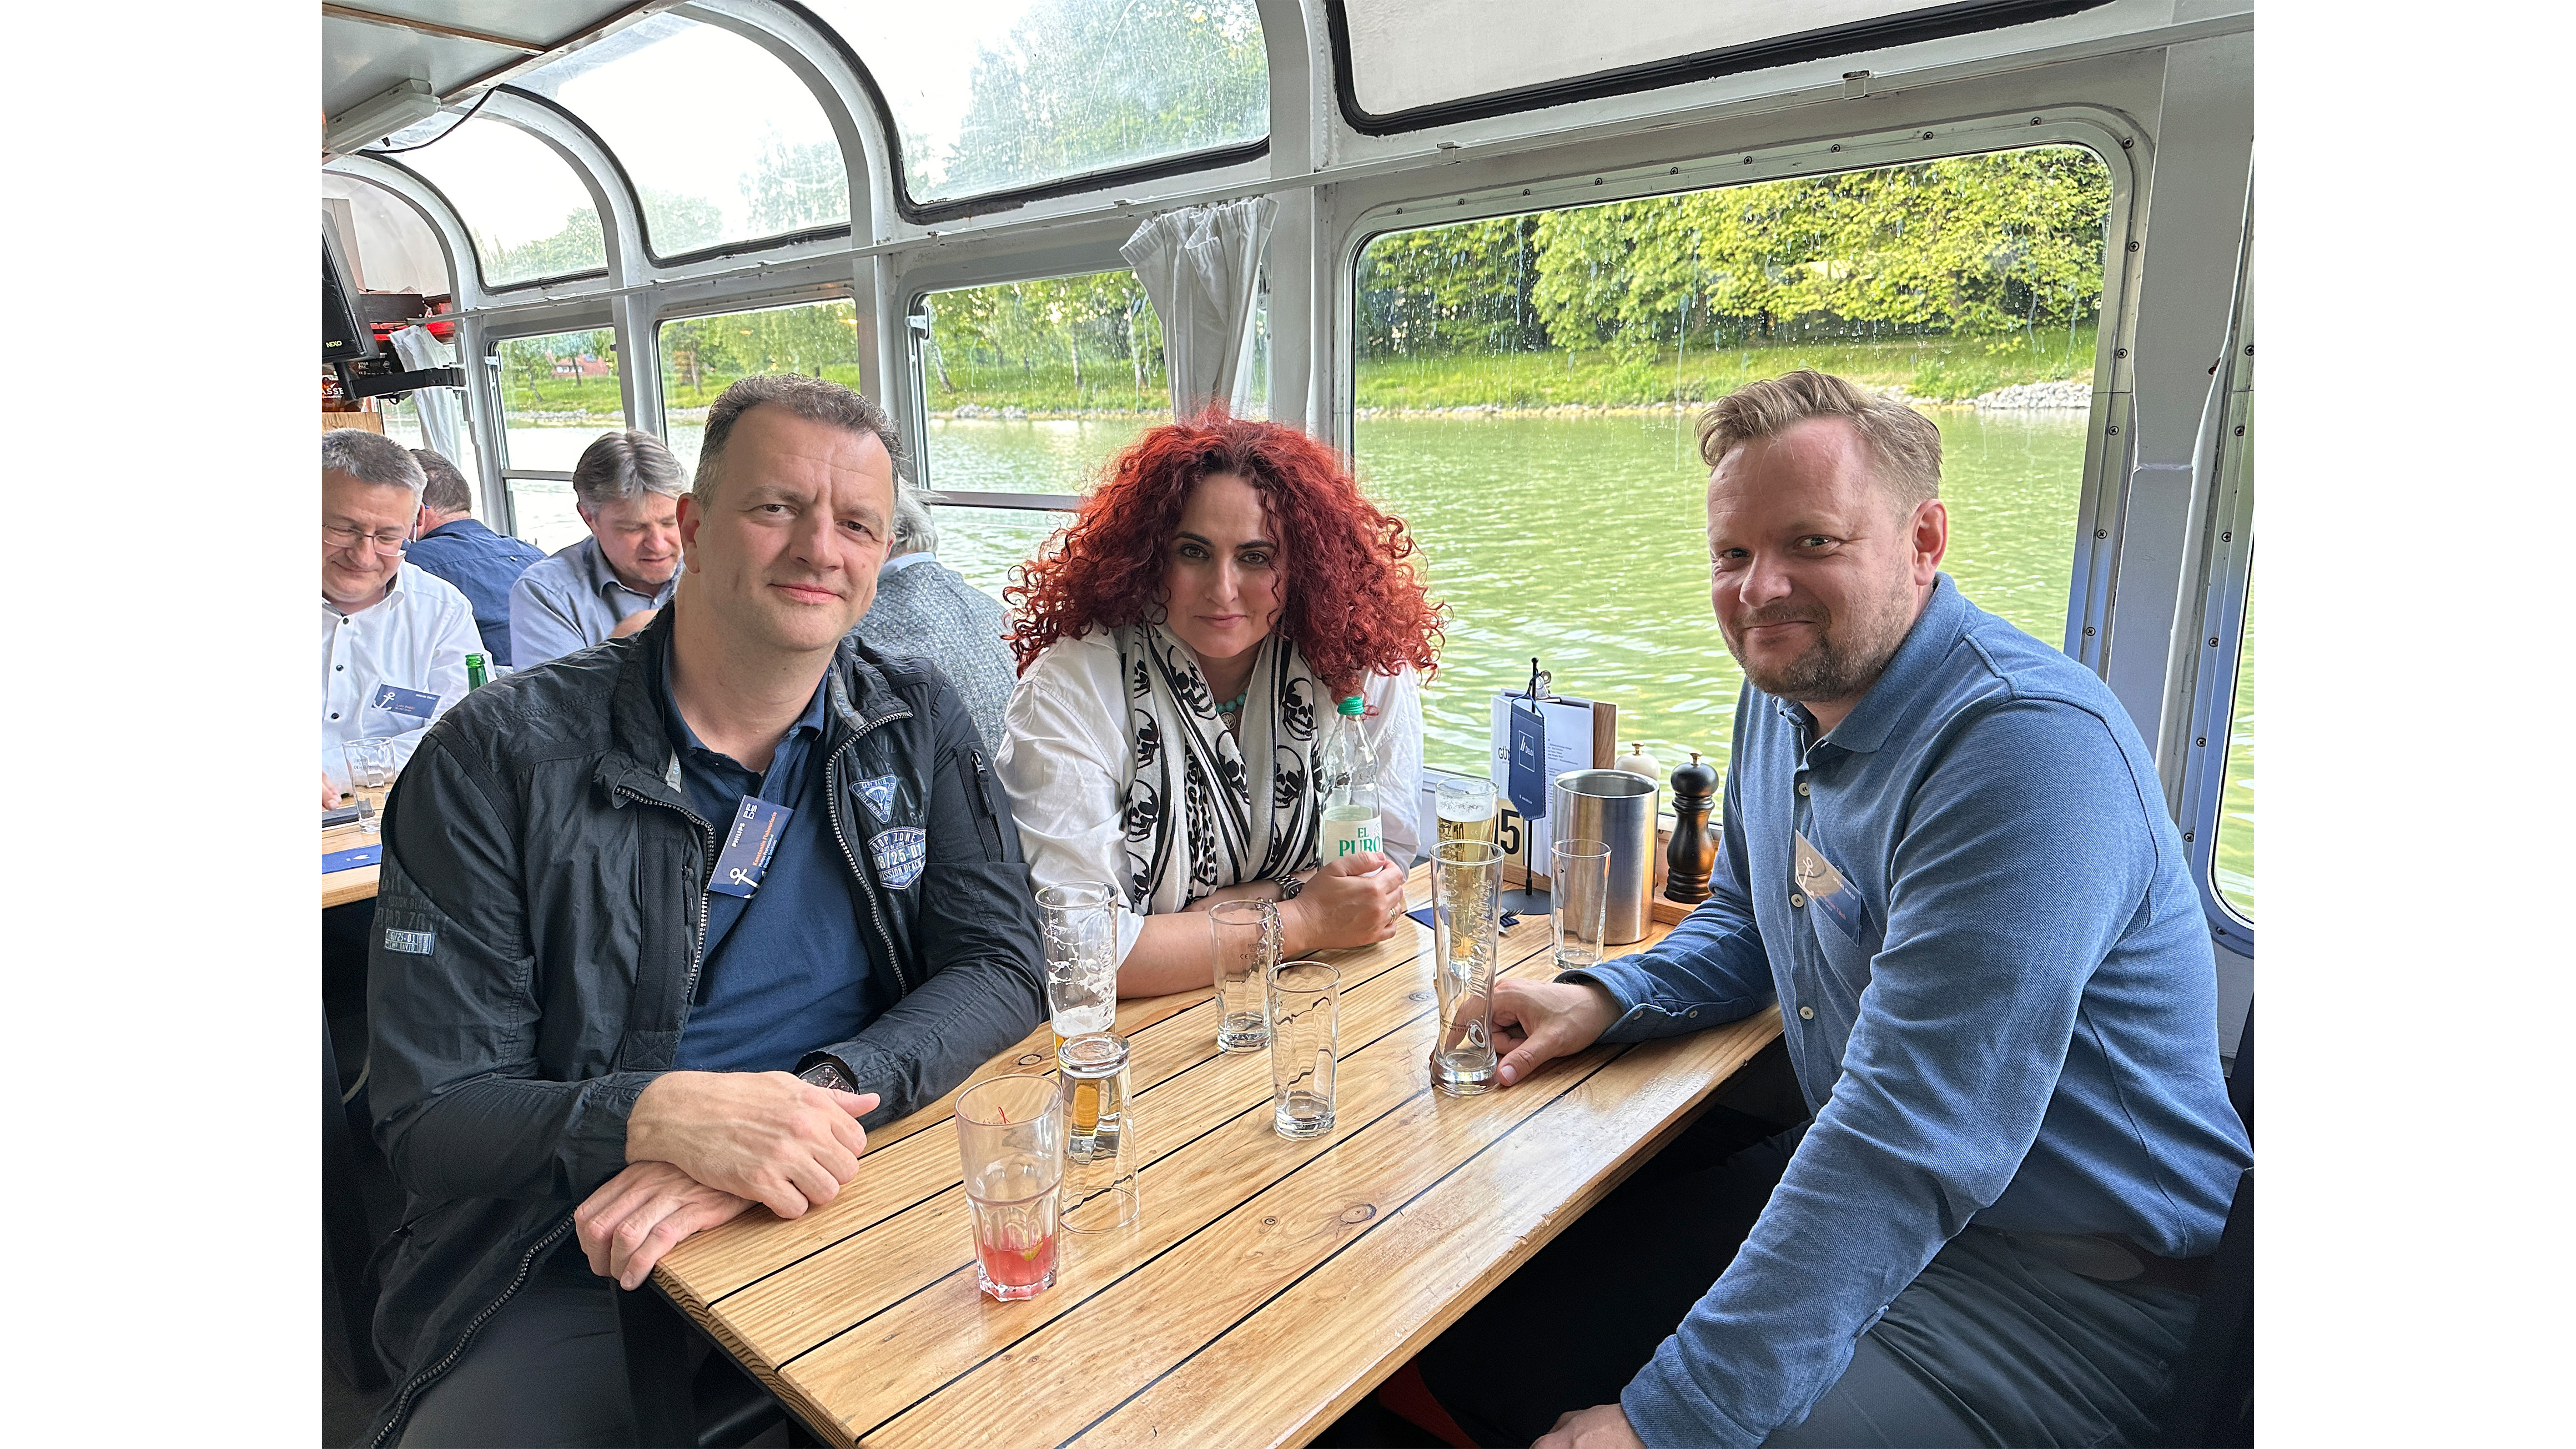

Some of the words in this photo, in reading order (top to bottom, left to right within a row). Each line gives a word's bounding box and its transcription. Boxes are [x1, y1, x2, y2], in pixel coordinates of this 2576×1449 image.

[868, 802, 883, 817] JUMPING
[731, 823, 745, 848] PHILIPS
[869, 836, 888, 854] DROP
[893, 832, 917, 843] ZONE
[1357, 827, 1369, 838] EL
[1491, 808, 1520, 857] 5
[1339, 836, 1381, 857] PURO
[878, 867, 903, 881] MISSION
[904, 858, 922, 873] BEACH
